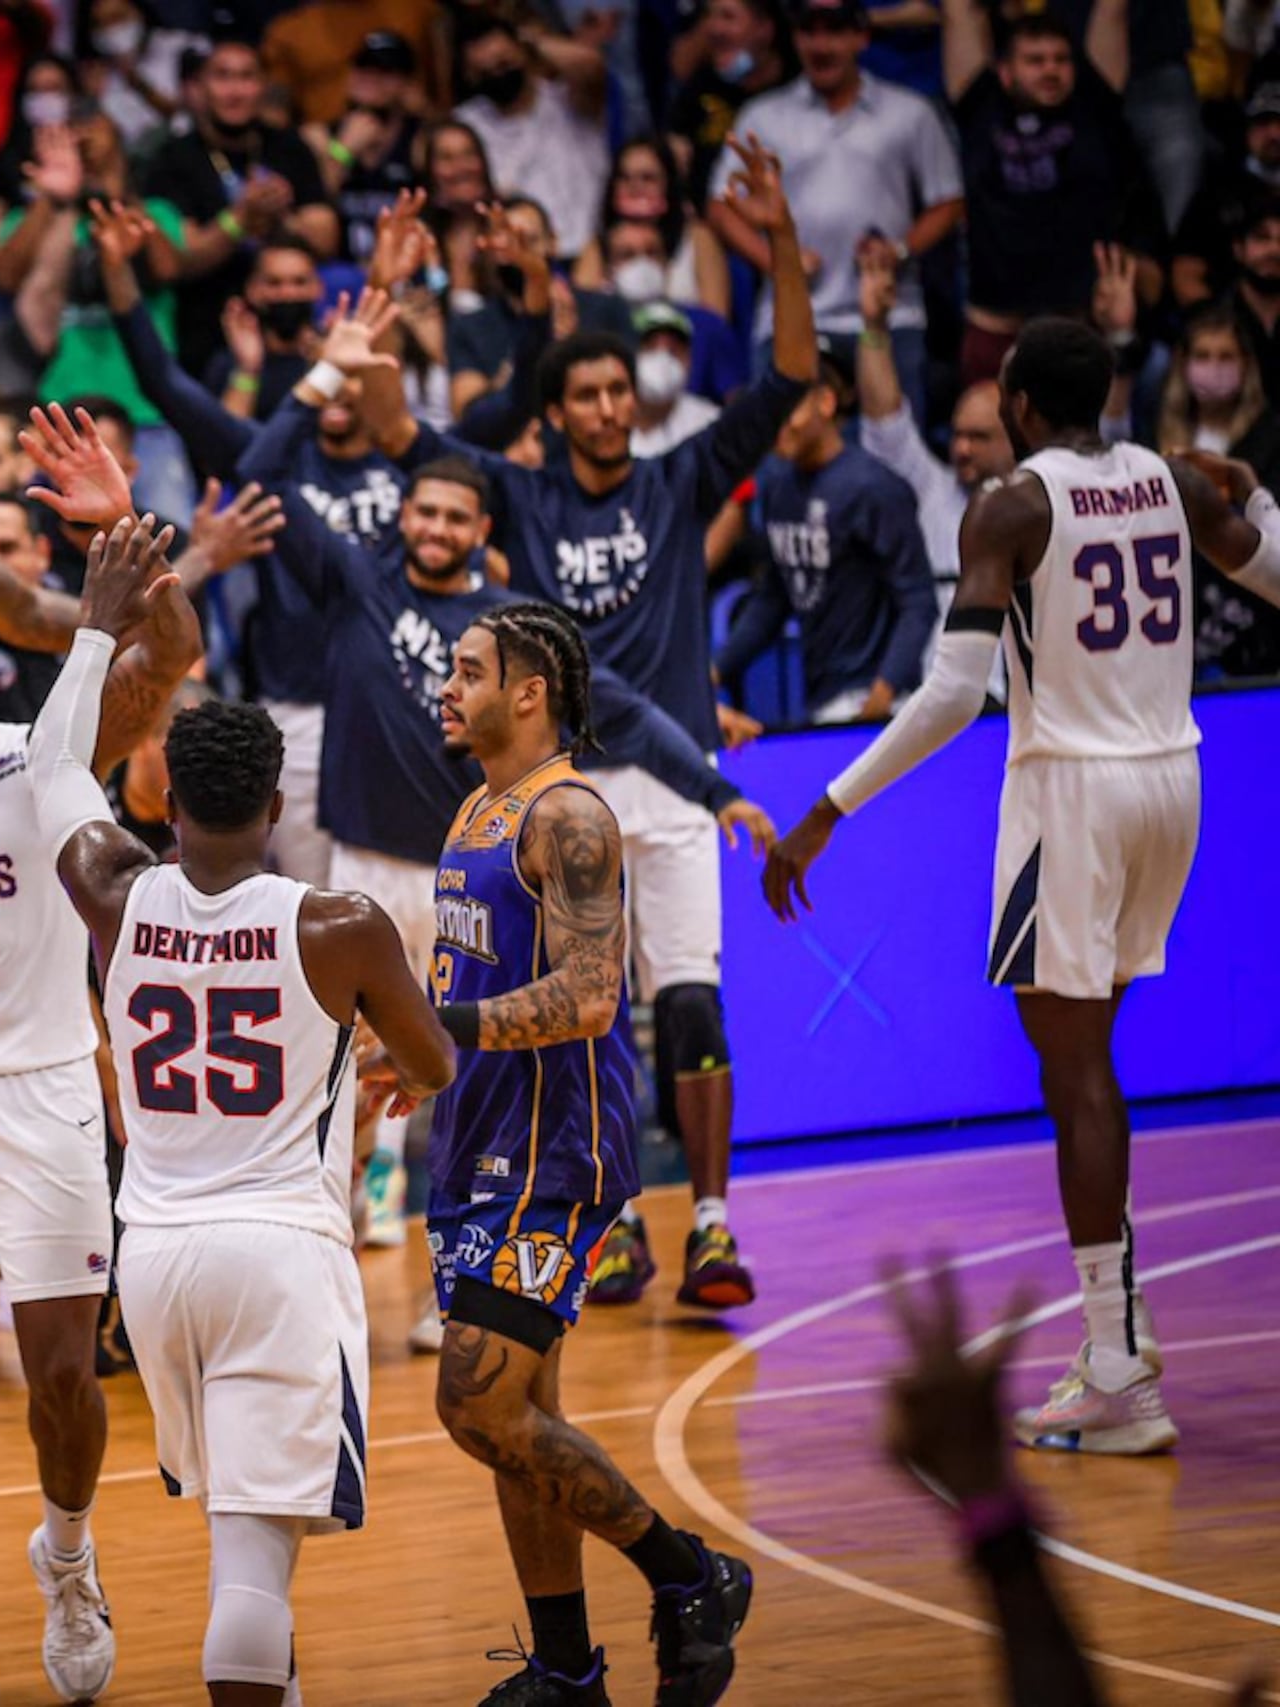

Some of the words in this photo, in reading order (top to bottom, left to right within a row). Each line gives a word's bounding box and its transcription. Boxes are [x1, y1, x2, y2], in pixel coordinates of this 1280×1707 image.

[1073, 533, 1181, 653] 35
[132, 922, 277, 962] DENTMON
[128, 982, 285, 1117] 25
